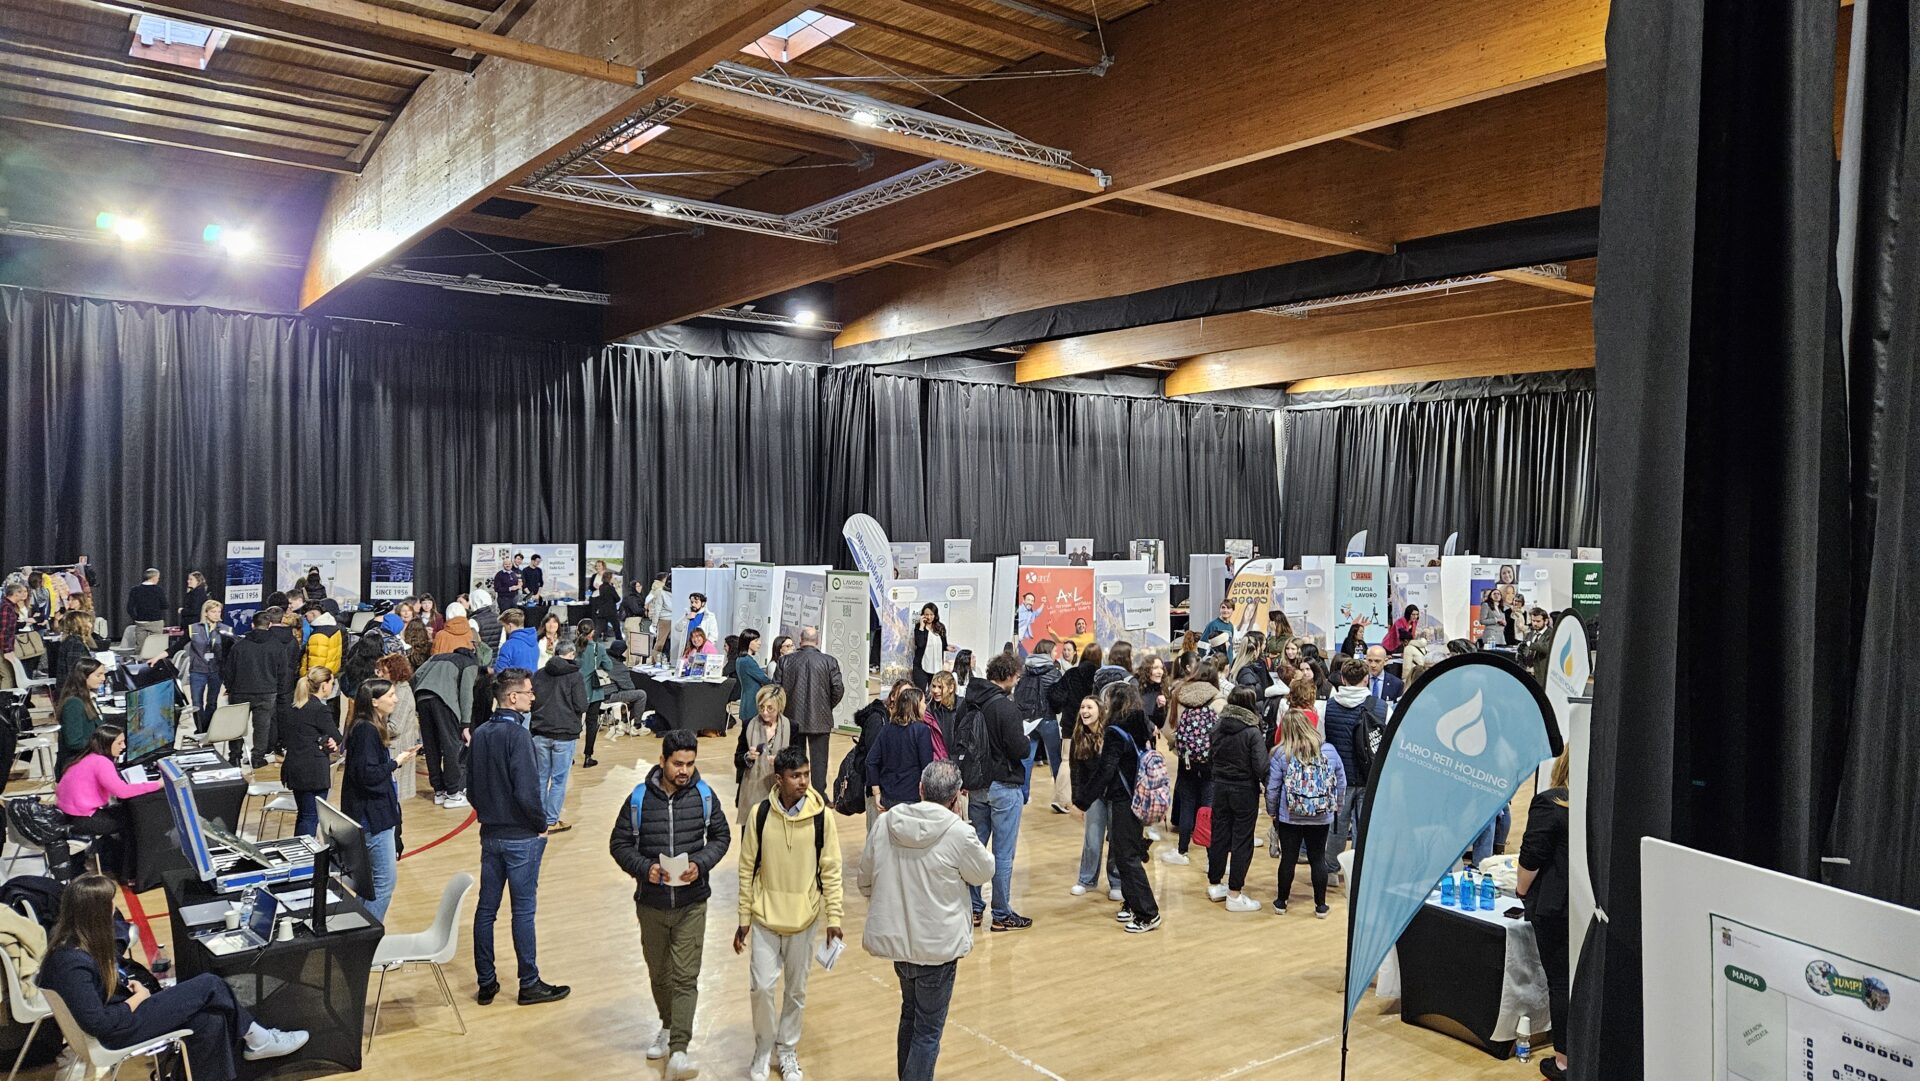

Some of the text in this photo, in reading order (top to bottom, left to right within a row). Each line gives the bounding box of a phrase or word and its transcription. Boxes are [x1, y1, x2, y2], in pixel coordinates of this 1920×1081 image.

[1400, 739, 1431, 759] LARIO
[1432, 752, 1453, 769] RETI
[1454, 760, 1508, 789] HOLDING
[1732, 970, 1760, 987] MAPPA
[1834, 976, 1862, 992] JUMP!
